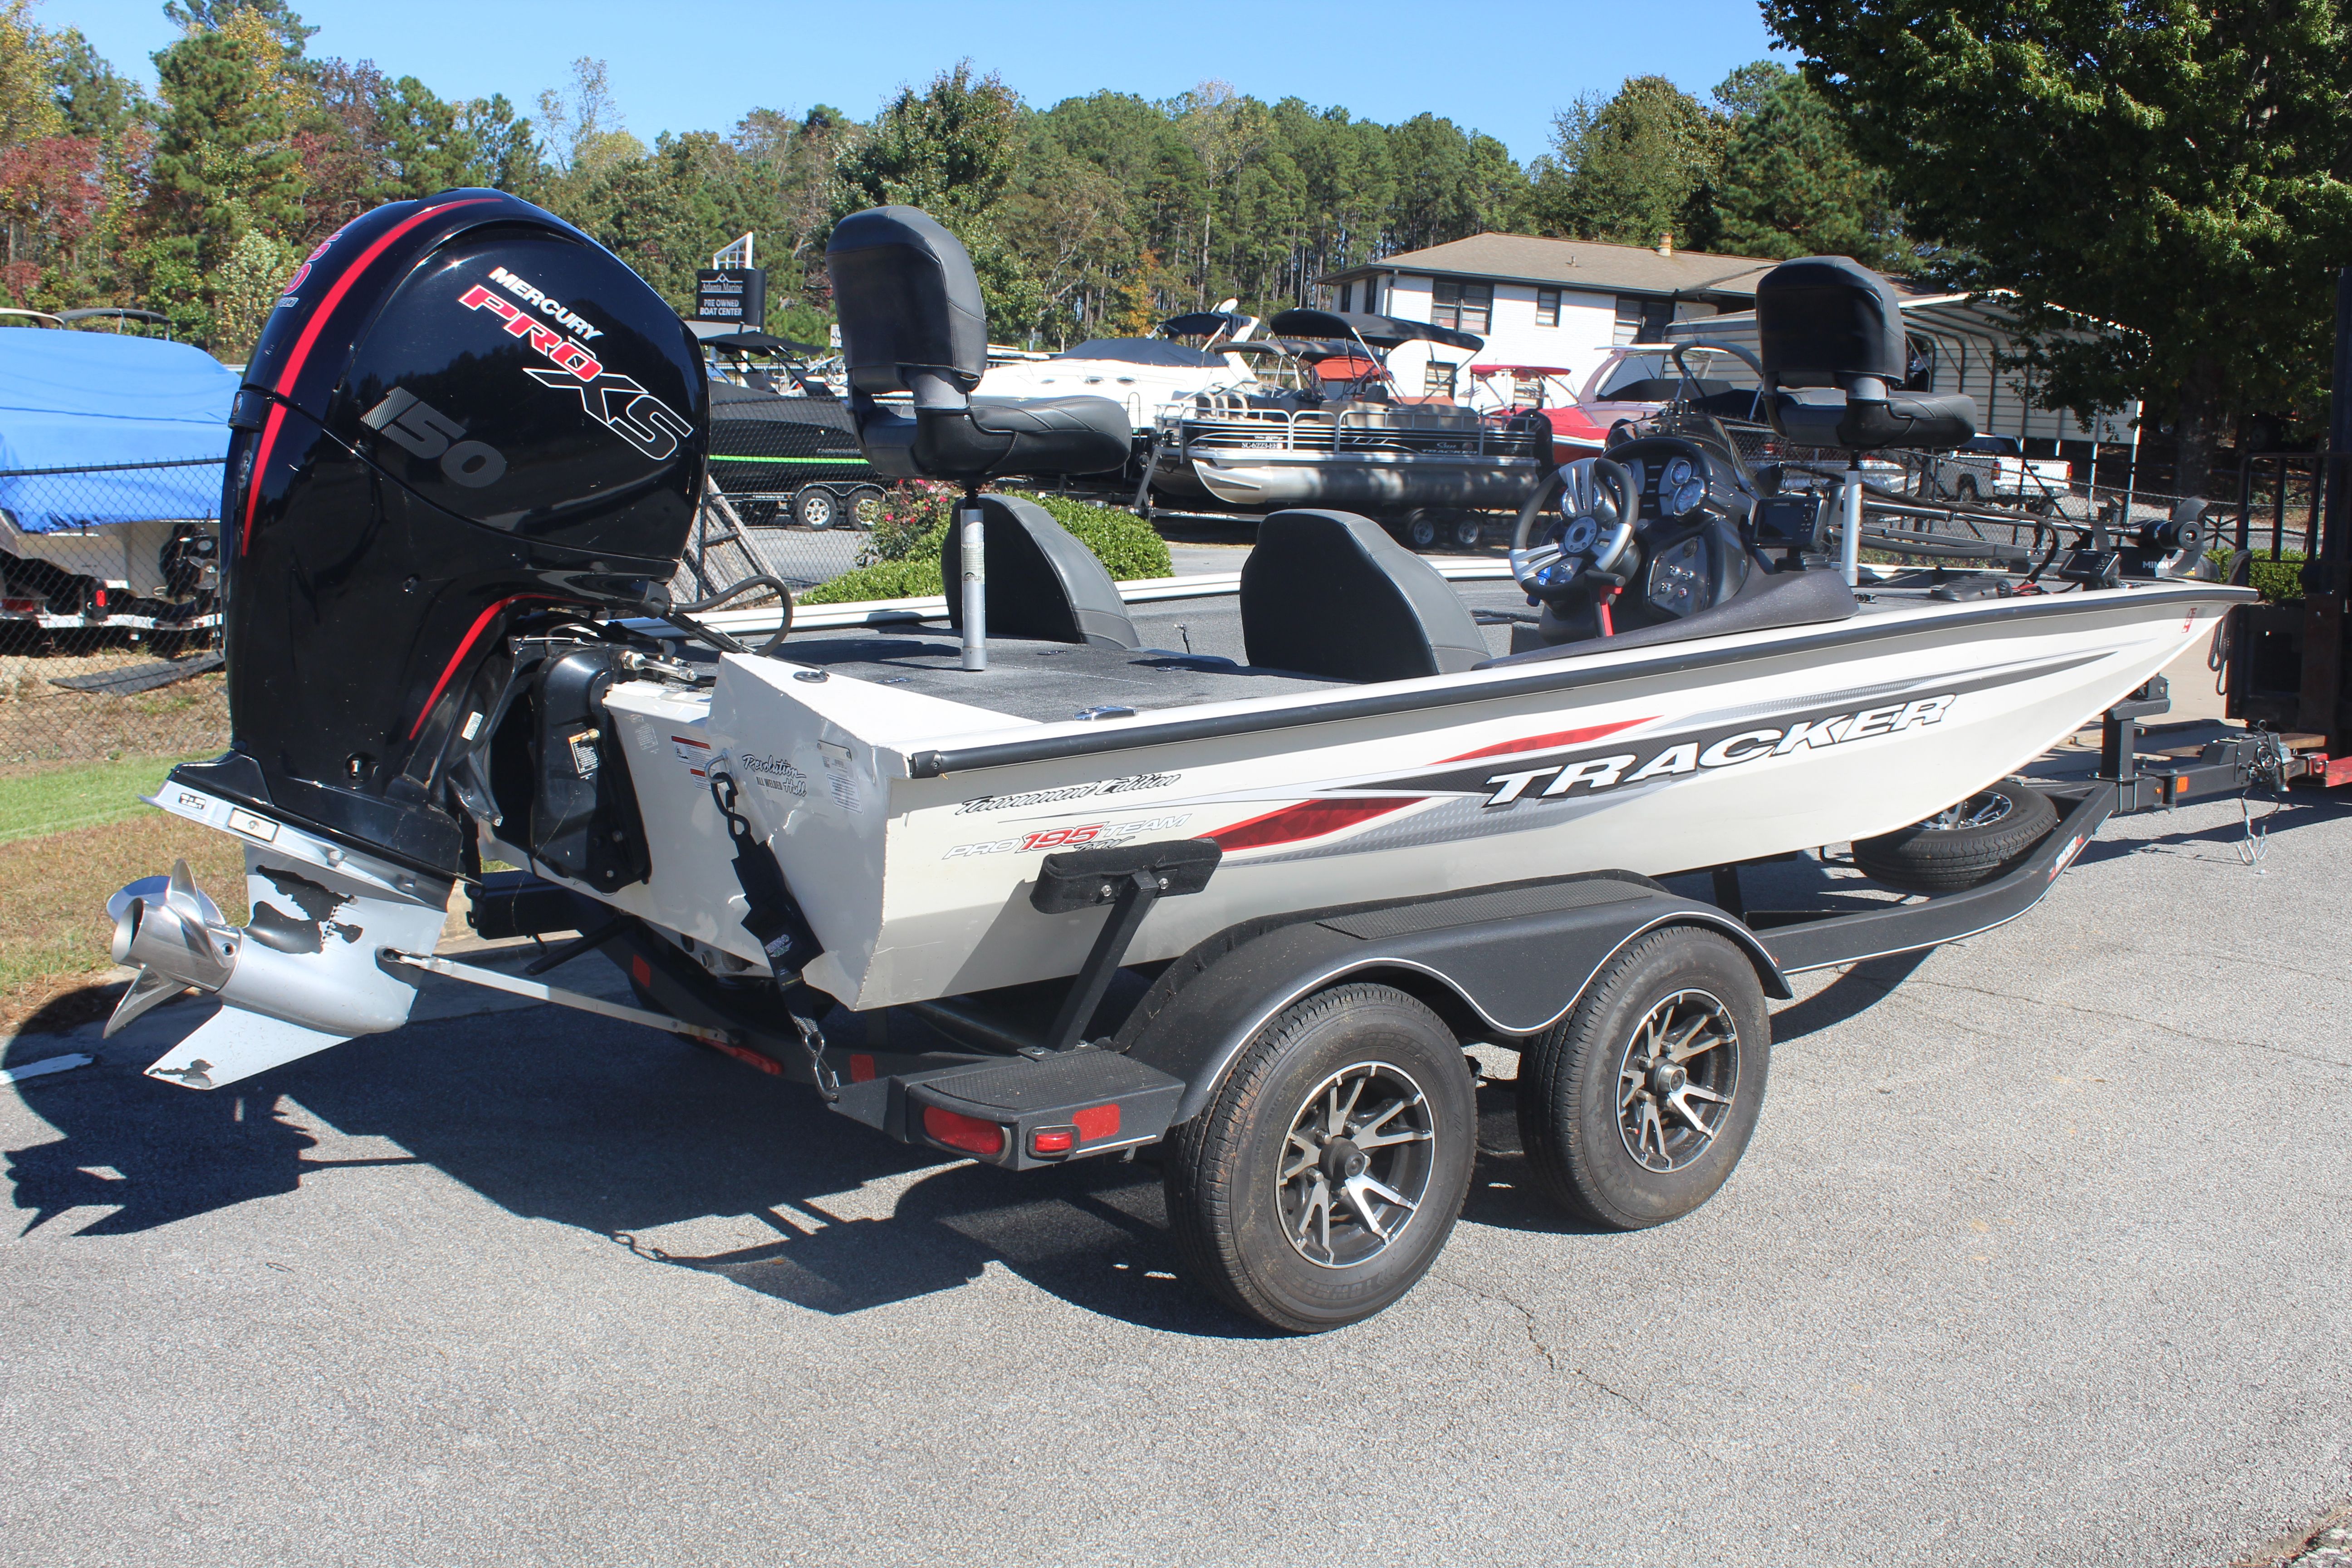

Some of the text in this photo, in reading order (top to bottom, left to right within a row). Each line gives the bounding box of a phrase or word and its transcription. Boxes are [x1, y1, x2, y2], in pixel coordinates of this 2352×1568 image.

[489, 266, 604, 340] MERCURY
[701, 283, 743, 292] Atlanta Marine
[704, 299, 740, 308] PRE OWNED
[700, 308, 742, 316] BOAT CENTER
[458, 284, 693, 460] PRO XS
[360, 386, 507, 488] 150
[2142, 561, 2168, 569] MINN
[742, 754, 807, 778] Revolution
[1484, 694, 1956, 808] TRACKER
[756, 776, 807, 797] ALL WELDED Hull
[955, 774, 1181, 815] Tournament Edition
[942, 813, 1193, 860] PRO 195 TEAM
